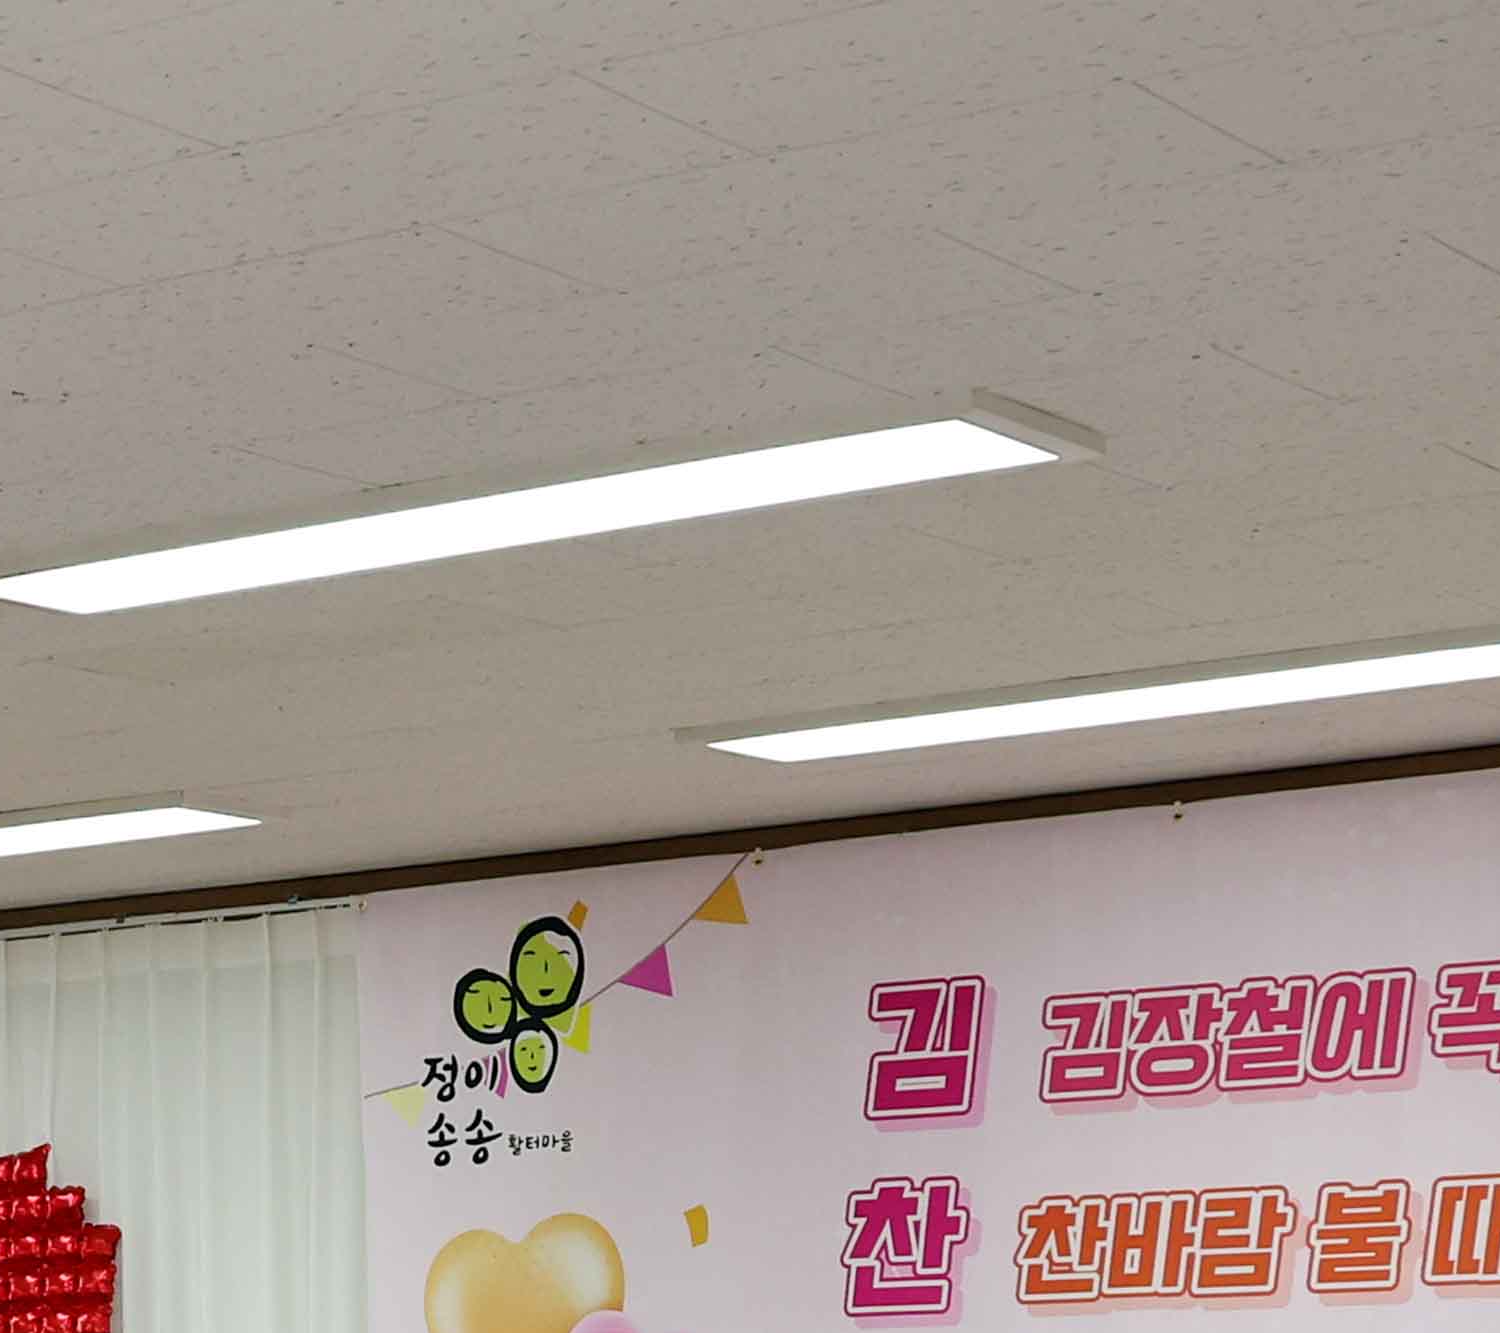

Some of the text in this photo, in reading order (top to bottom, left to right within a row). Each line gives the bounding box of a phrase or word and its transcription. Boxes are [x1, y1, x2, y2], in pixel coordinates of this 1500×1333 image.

[420, 1052, 500, 1104] 정이
[865, 975, 988, 1122] 김
[1040, 968, 1415, 1106] 김장철에
[426, 1106, 504, 1168] 송송
[841, 1175, 969, 1320] 찬
[1015, 1184, 1296, 1304] 찬바람
[1308, 1178, 1411, 1292] 불
